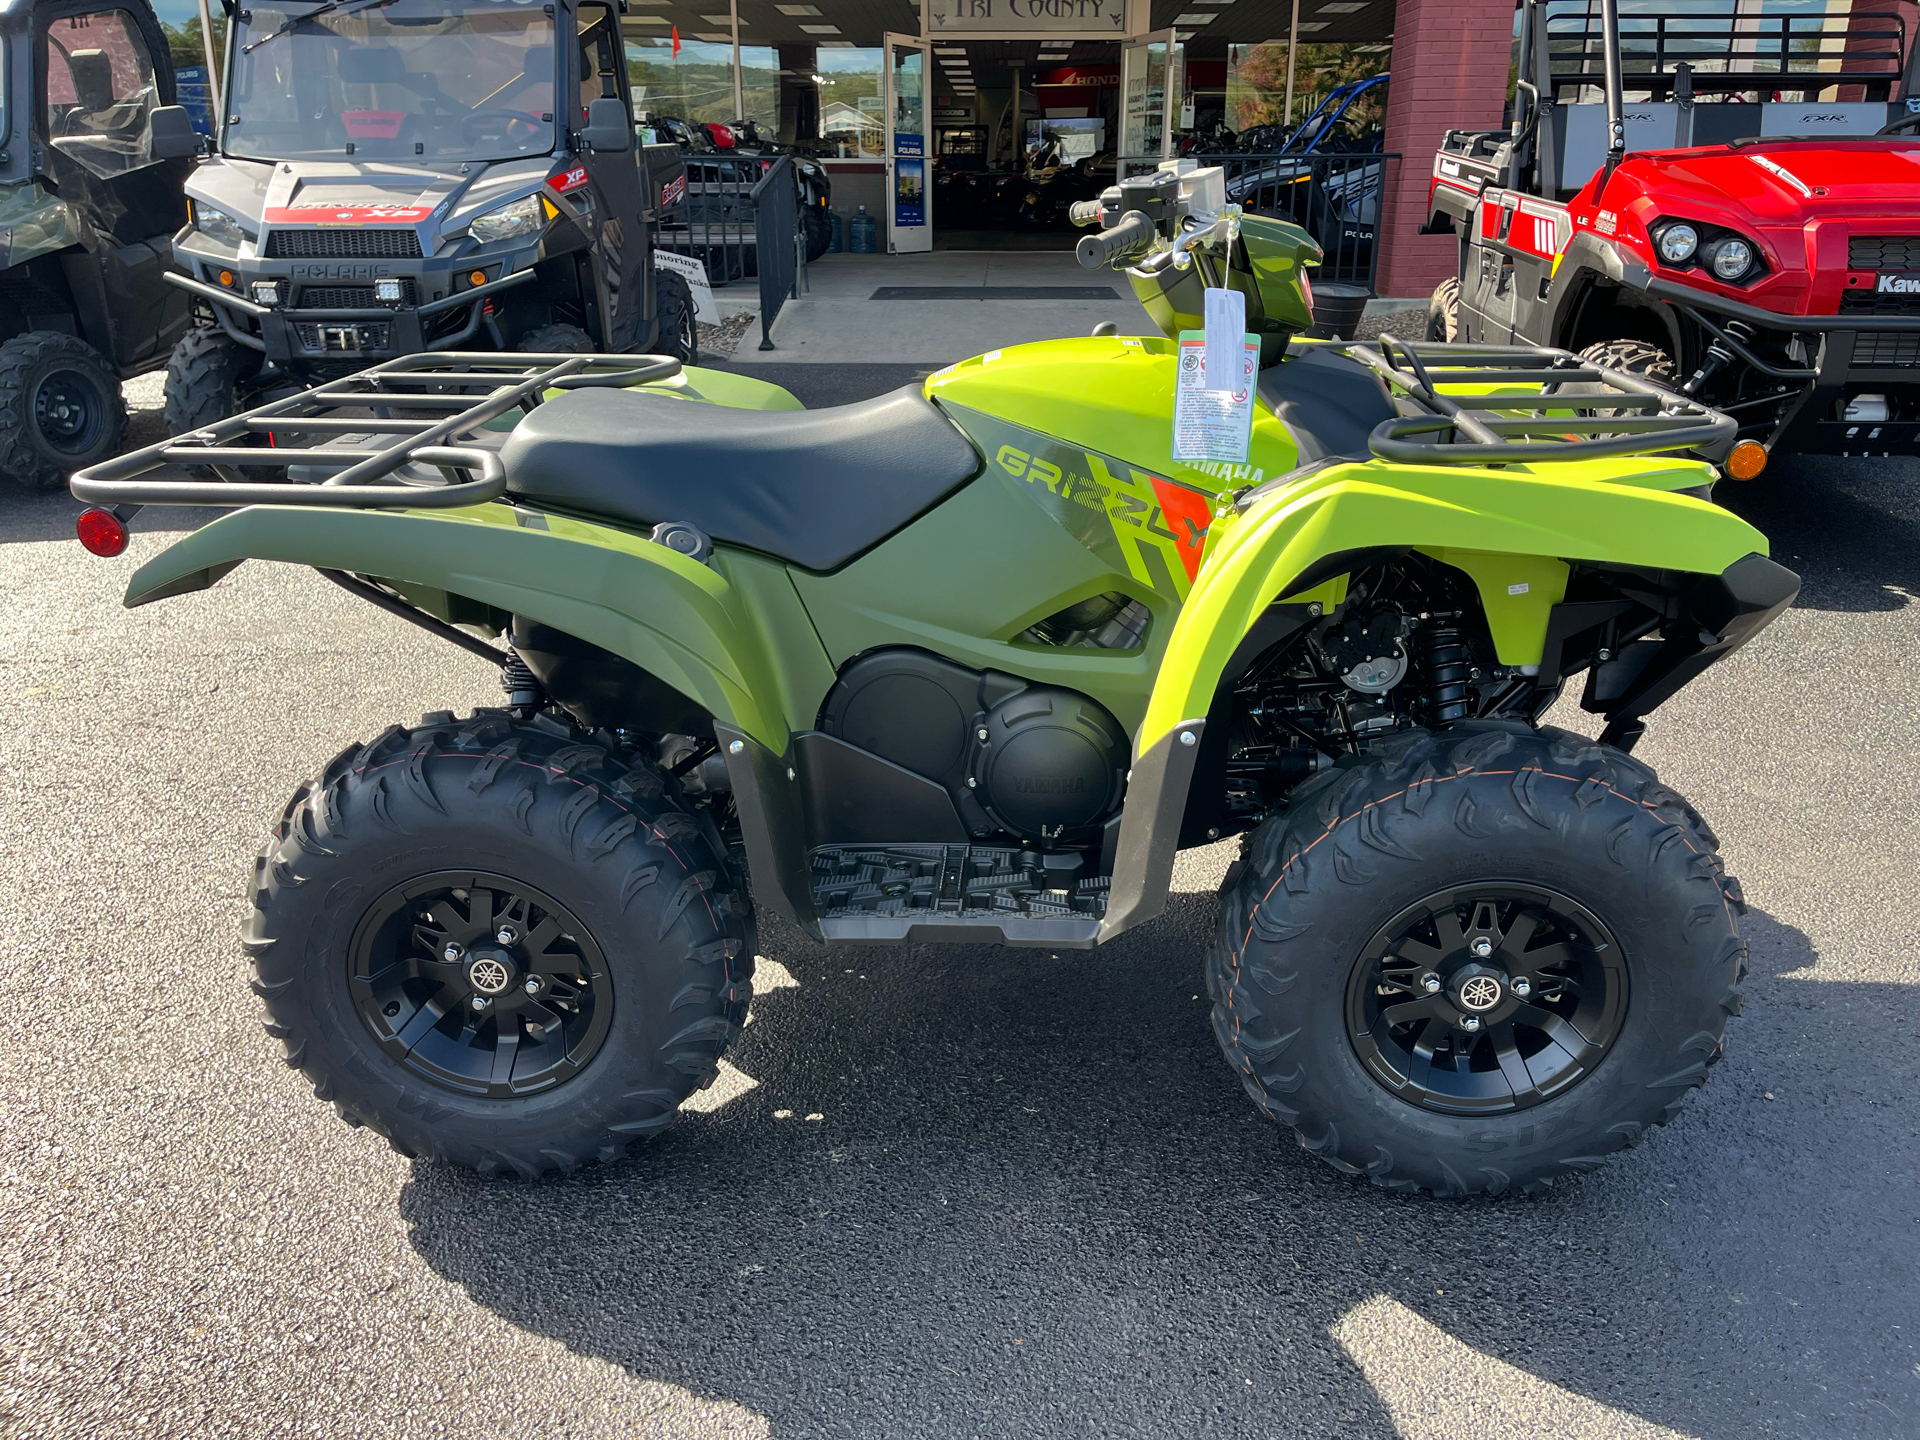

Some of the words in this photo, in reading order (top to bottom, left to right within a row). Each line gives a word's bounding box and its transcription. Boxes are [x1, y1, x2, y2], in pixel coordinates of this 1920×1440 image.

[176, 70, 199, 79] POLARIS
[1075, 74, 1120, 85] HOND
[898, 146, 921, 155] POLARIS
[566, 168, 585, 184] XP
[364, 209, 421, 218] XP
[433, 201, 450, 218] 900
[1576, 214, 1589, 227] LE
[1344, 230, 1374, 240] POLA
[653, 252, 700, 271] onoring
[291, 264, 391, 280] POLARIS
[1177, 460, 1264, 482] AMAHA
[996, 444, 1208, 549] GRIZZLY
[1013, 775, 1086, 795] YAMAHA
